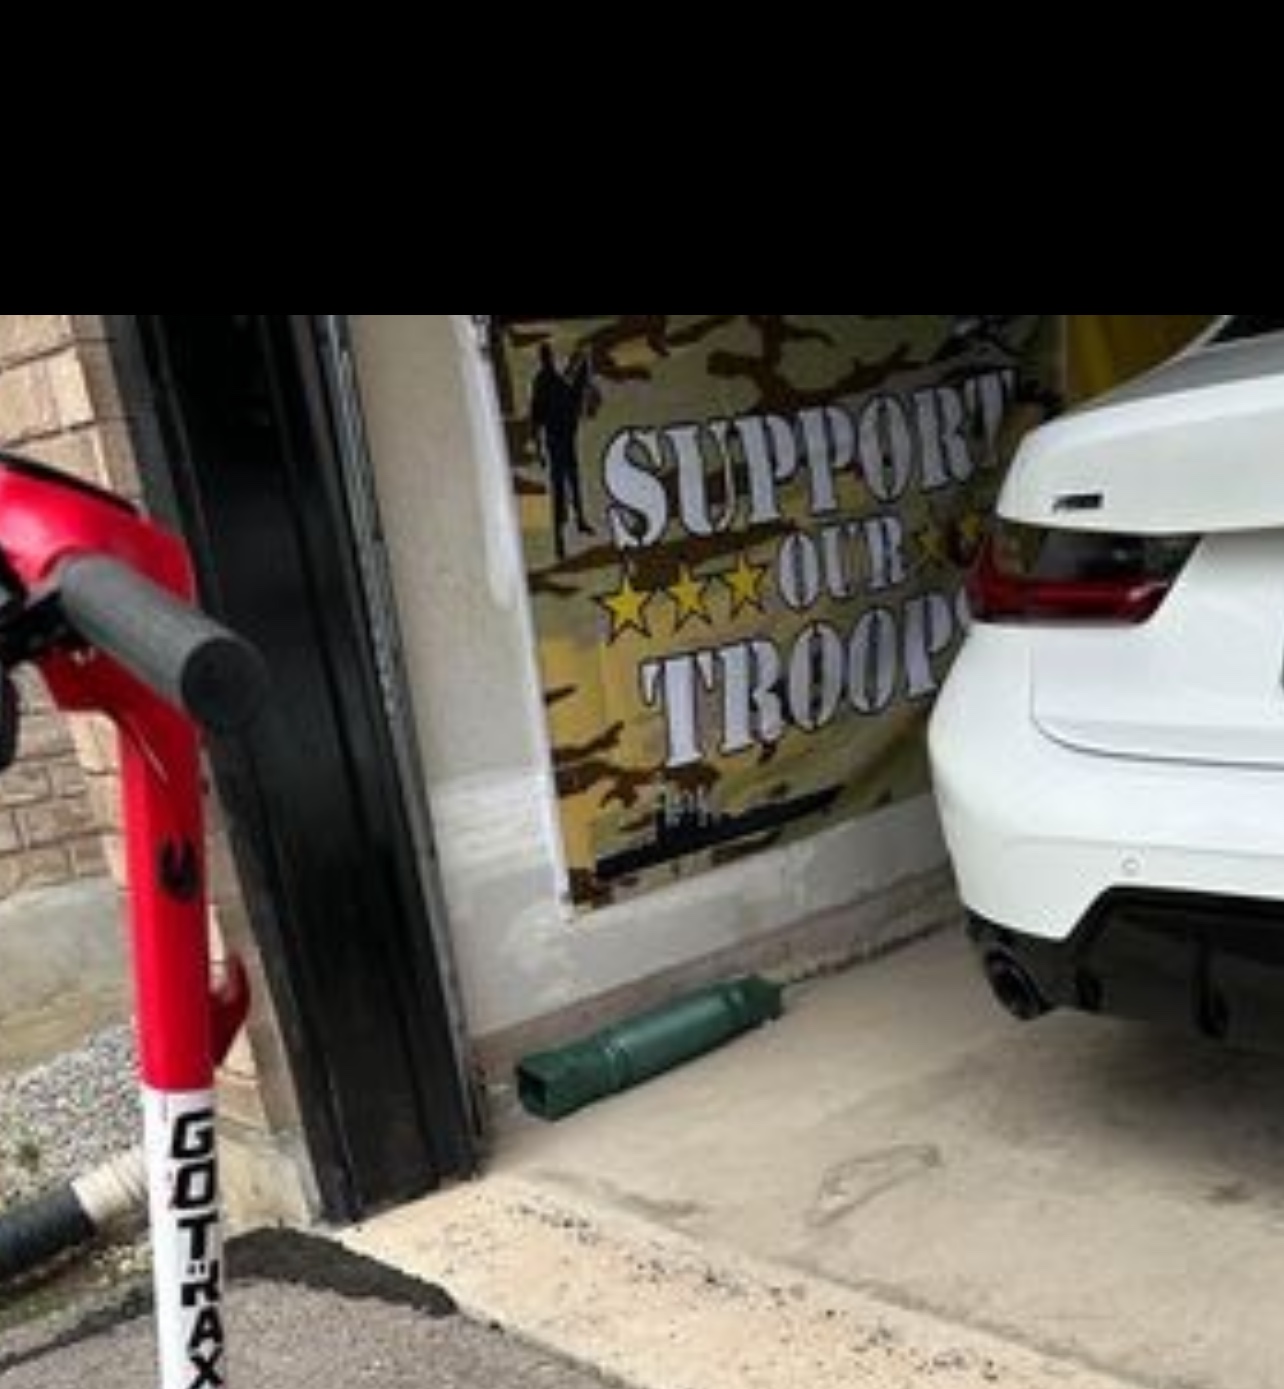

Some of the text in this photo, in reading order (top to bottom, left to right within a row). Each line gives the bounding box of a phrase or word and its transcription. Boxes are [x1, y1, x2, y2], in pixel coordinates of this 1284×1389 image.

[603, 369, 1014, 549] SUPPORT
[776, 515, 906, 608] OUR
[641, 593, 970, 768] TROOP
